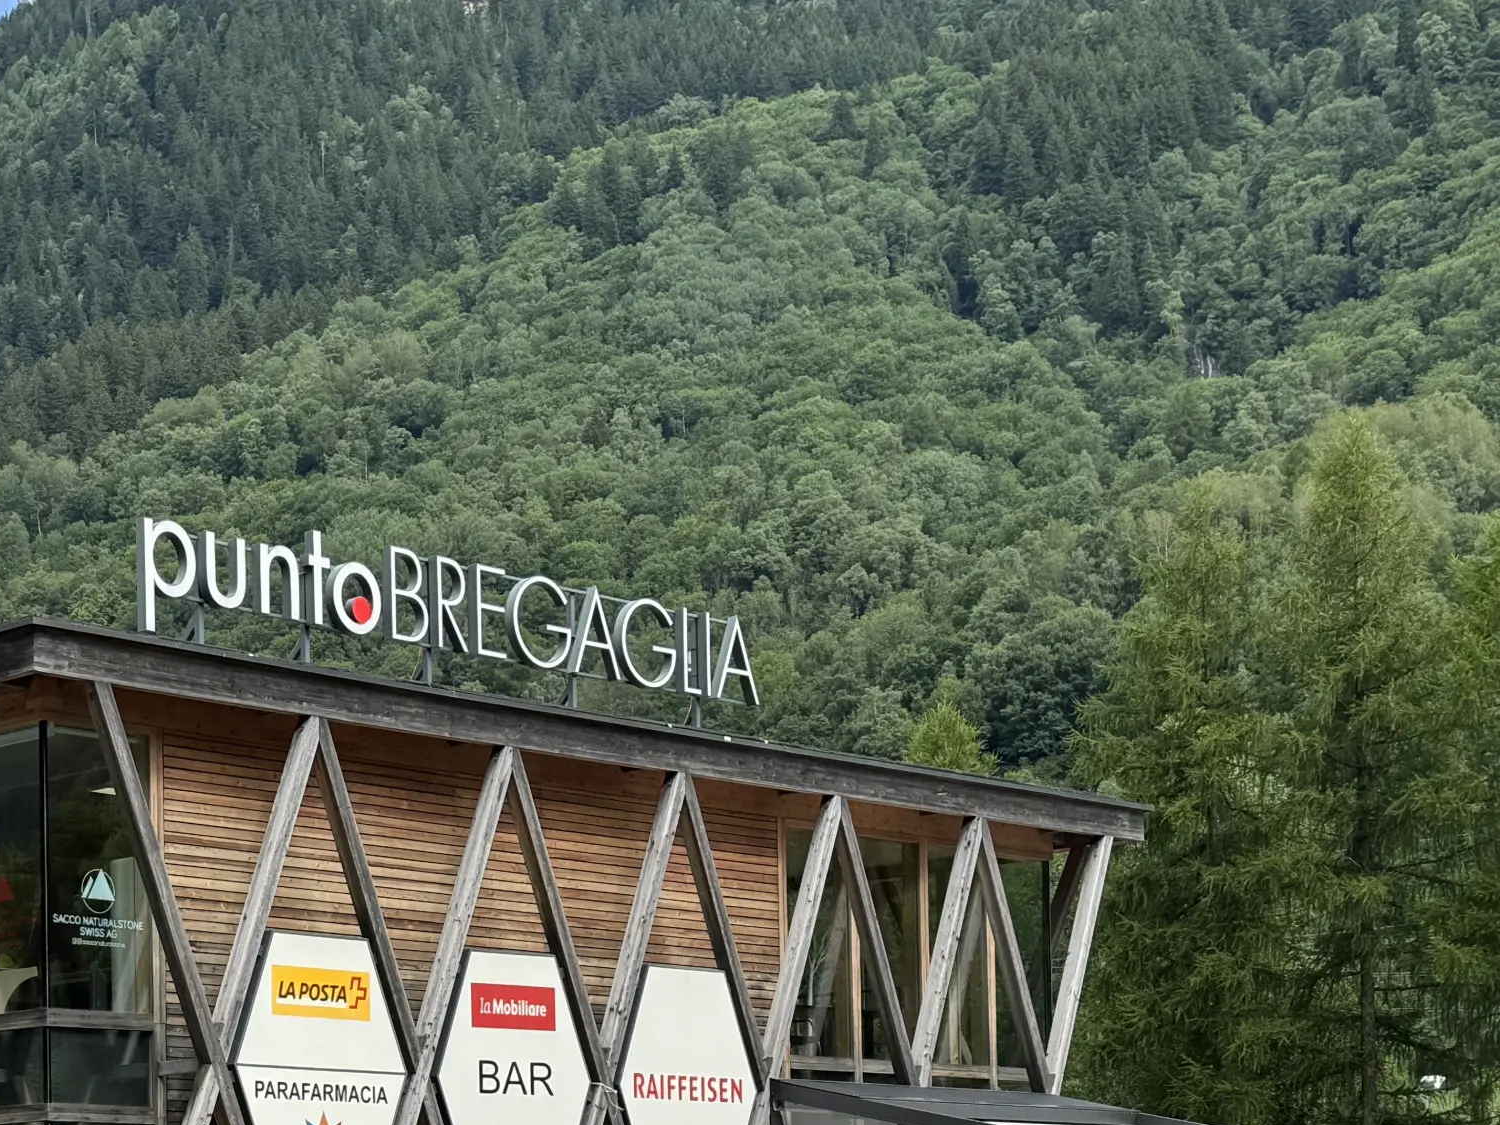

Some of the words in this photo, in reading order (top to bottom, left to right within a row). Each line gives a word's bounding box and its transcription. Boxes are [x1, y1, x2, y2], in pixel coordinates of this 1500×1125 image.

[52, 913, 81, 925] SACCO
[82, 916, 144, 930] NATURALSTONE
[80, 926, 105, 938] SWISS
[106, 930, 118, 939] AG
[278, 980, 296, 1000] LA
[298, 982, 348, 1004] POSTA
[479, 1059, 554, 1097] BAR
[633, 1072, 743, 1104] RAIFFEISEN
[254, 1080, 389, 1105] PARAFARMACIA
